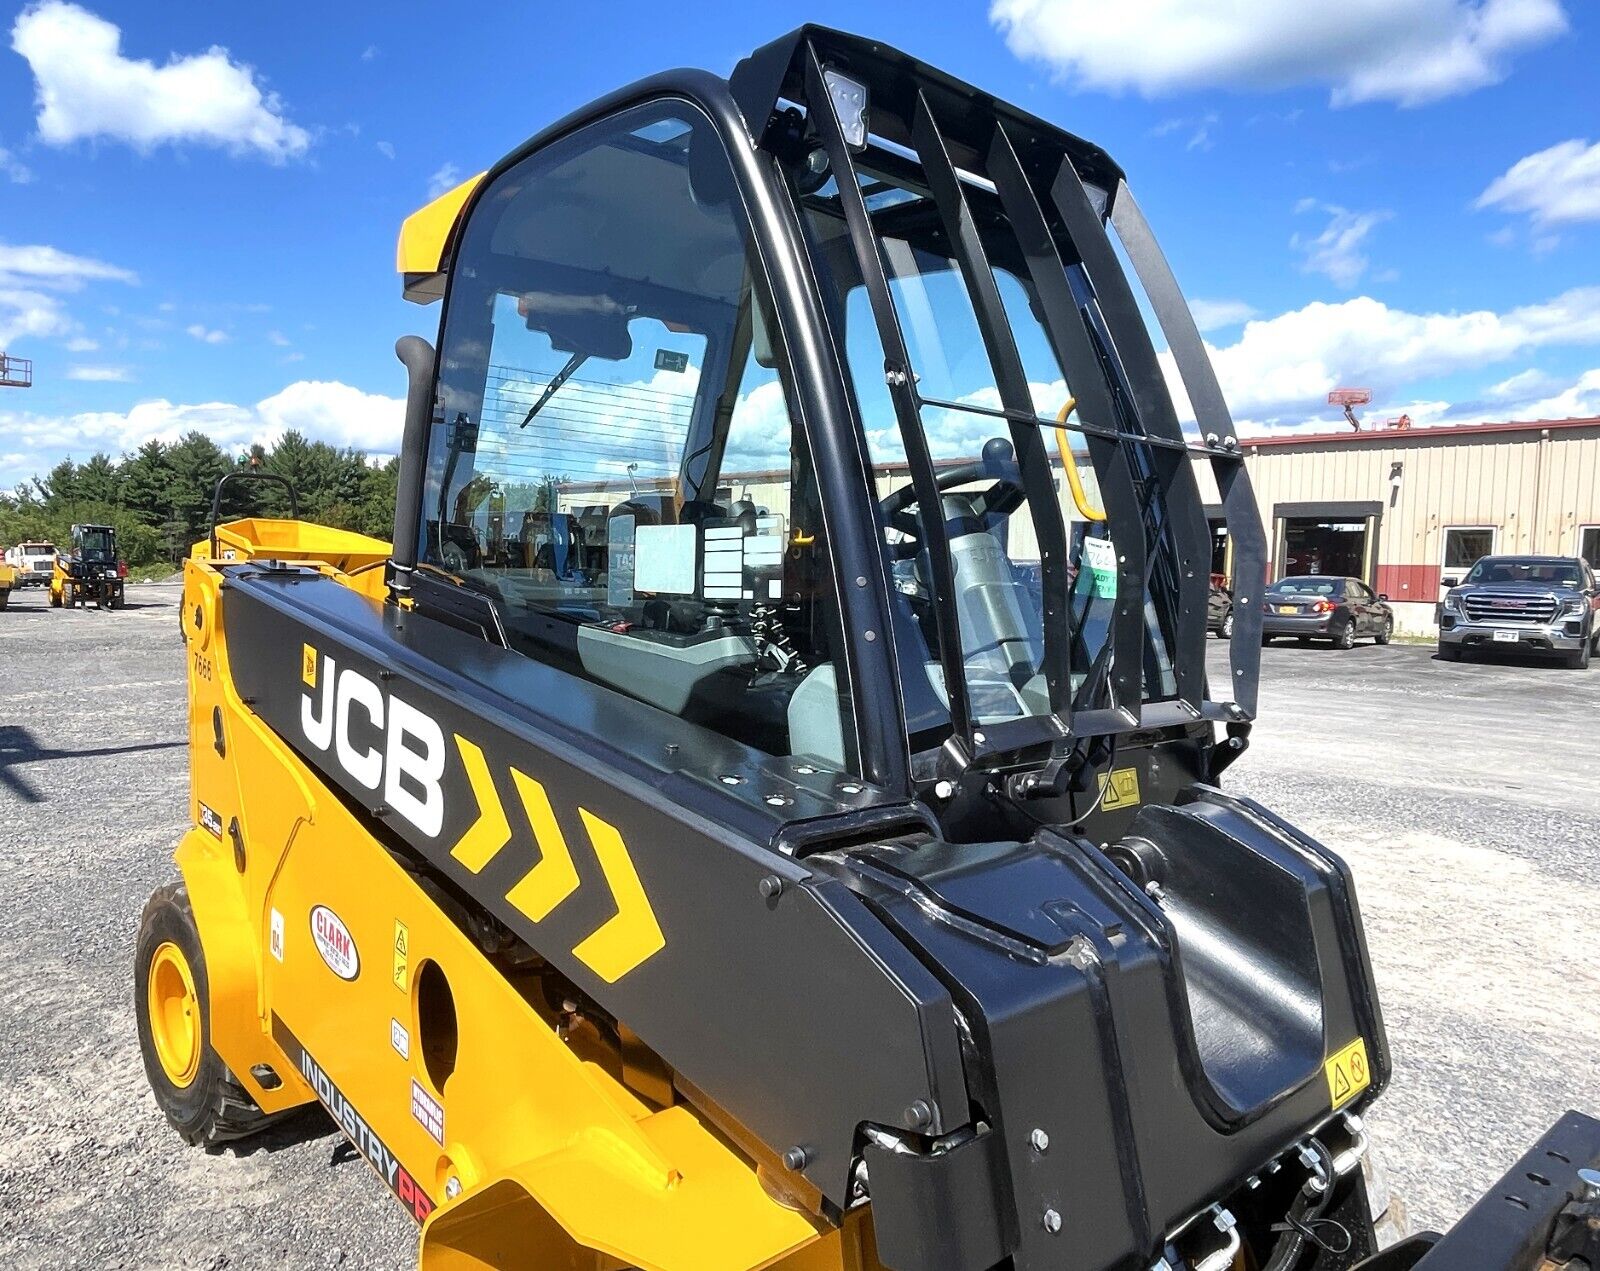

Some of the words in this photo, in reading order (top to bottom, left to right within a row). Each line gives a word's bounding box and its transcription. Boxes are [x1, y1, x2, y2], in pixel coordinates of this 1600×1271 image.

[195, 652, 212, 681] 7666
[301, 654, 446, 838] JCB
[317, 911, 350, 960] CLARK
